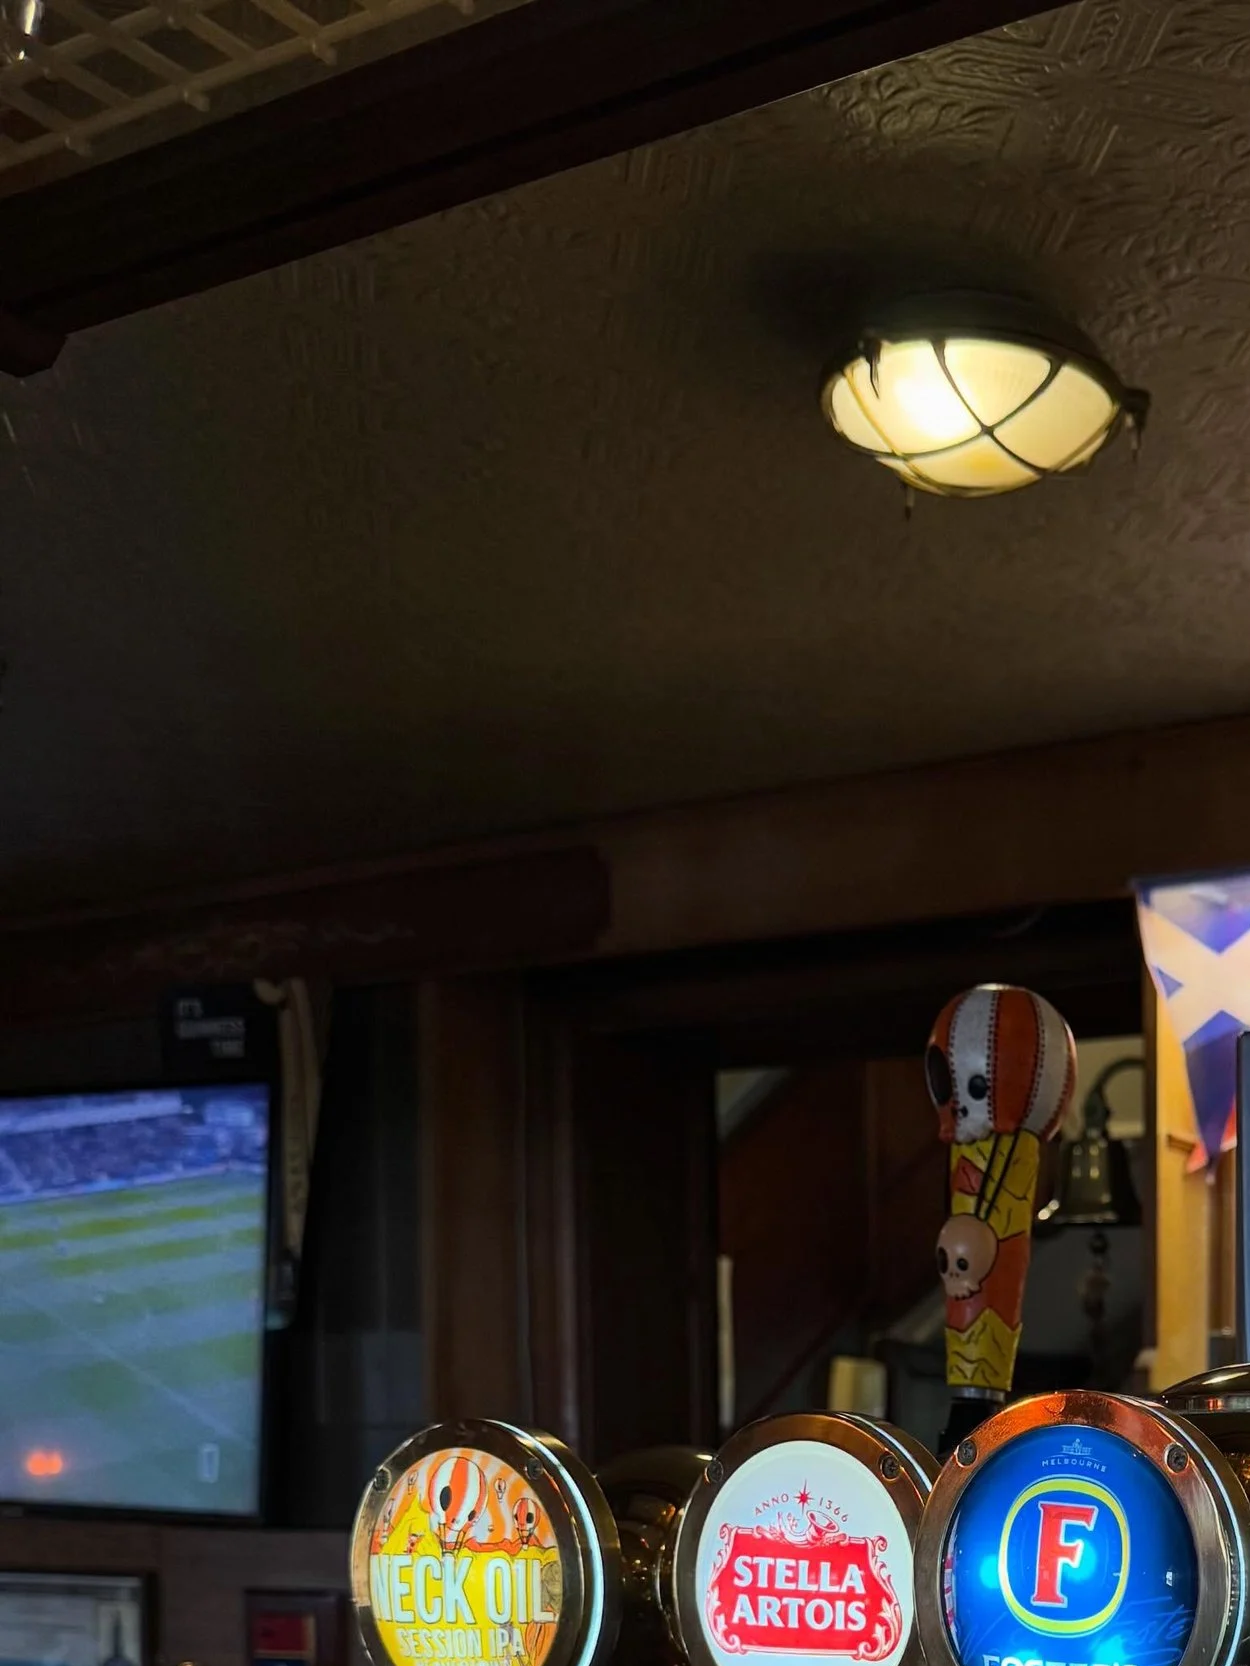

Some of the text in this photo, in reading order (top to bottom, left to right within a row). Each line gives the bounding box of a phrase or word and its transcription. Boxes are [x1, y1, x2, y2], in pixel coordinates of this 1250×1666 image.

[1041, 1458, 1107, 1473] MELBOURNE
[754, 1493, 849, 1523] ANNO 1366
[1030, 1500, 1099, 1610] F
[369, 1553, 558, 1625] NECK OIL
[732, 1555, 867, 1595] STELLA
[731, 1594, 868, 1633] ARTOIS
[397, 1628, 527, 1660] SESSION IPA
